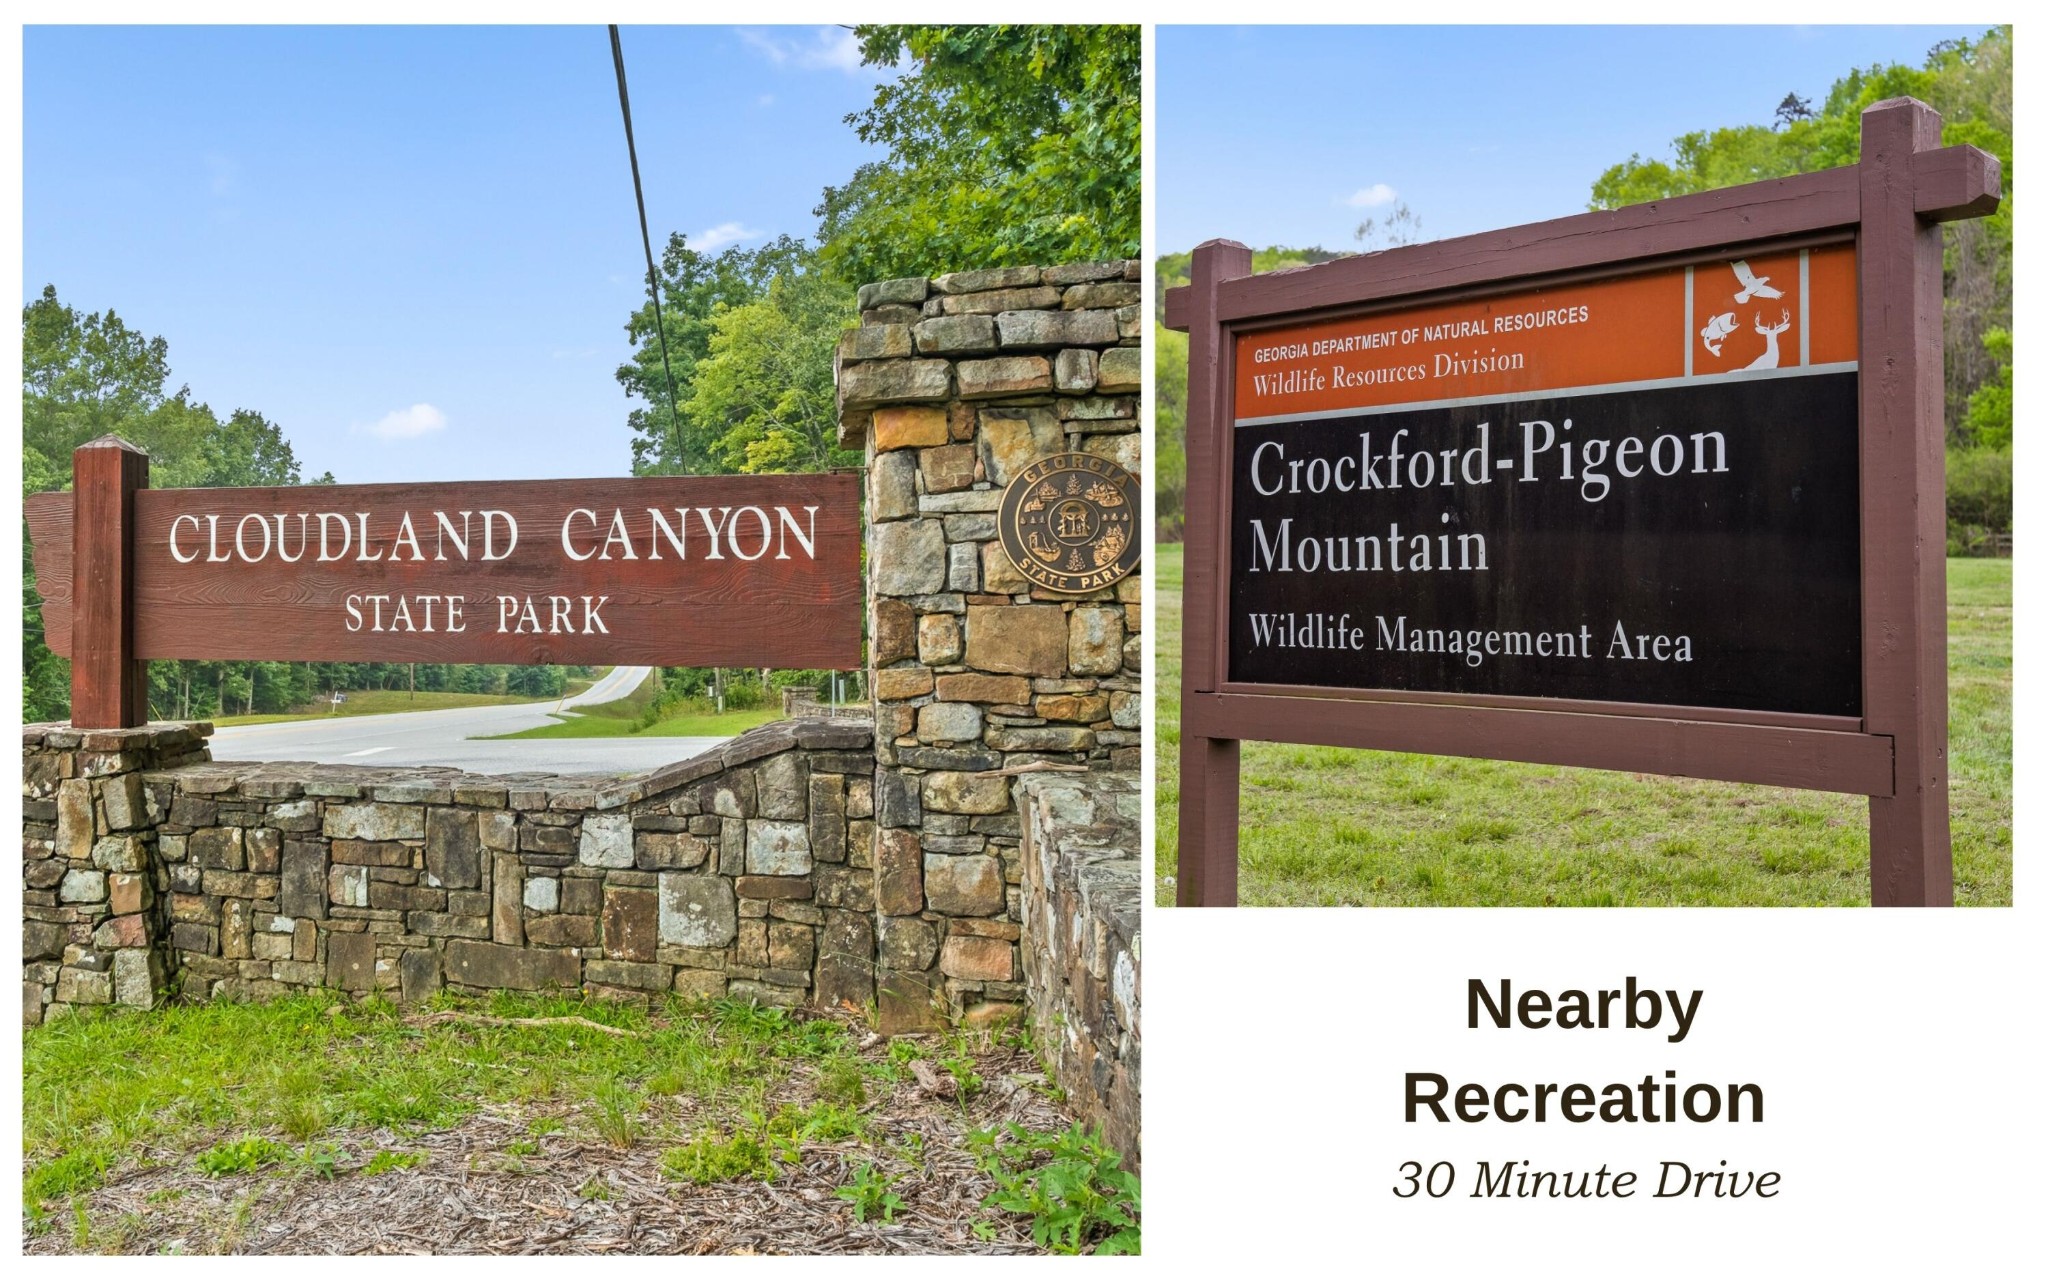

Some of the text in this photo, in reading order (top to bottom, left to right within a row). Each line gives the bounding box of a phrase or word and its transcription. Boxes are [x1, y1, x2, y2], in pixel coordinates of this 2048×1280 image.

[1255, 305, 1589, 364] GEORGIA DEPARTMENT OF NATURAL RESOURCES
[1254, 350, 1524, 397] Wildlife Resources Division
[1023, 455, 1130, 488] GEORGIA
[1251, 419, 1729, 502] Crockford-Pigeon
[169, 506, 818, 563] CLOUDLAND CANYON
[1249, 514, 1488, 573] Mountain
[1020, 558, 1125, 588] STATE PARK
[345, 594, 610, 635] STATE PARK
[1249, 612, 1693, 666] Wildlife Management Area
